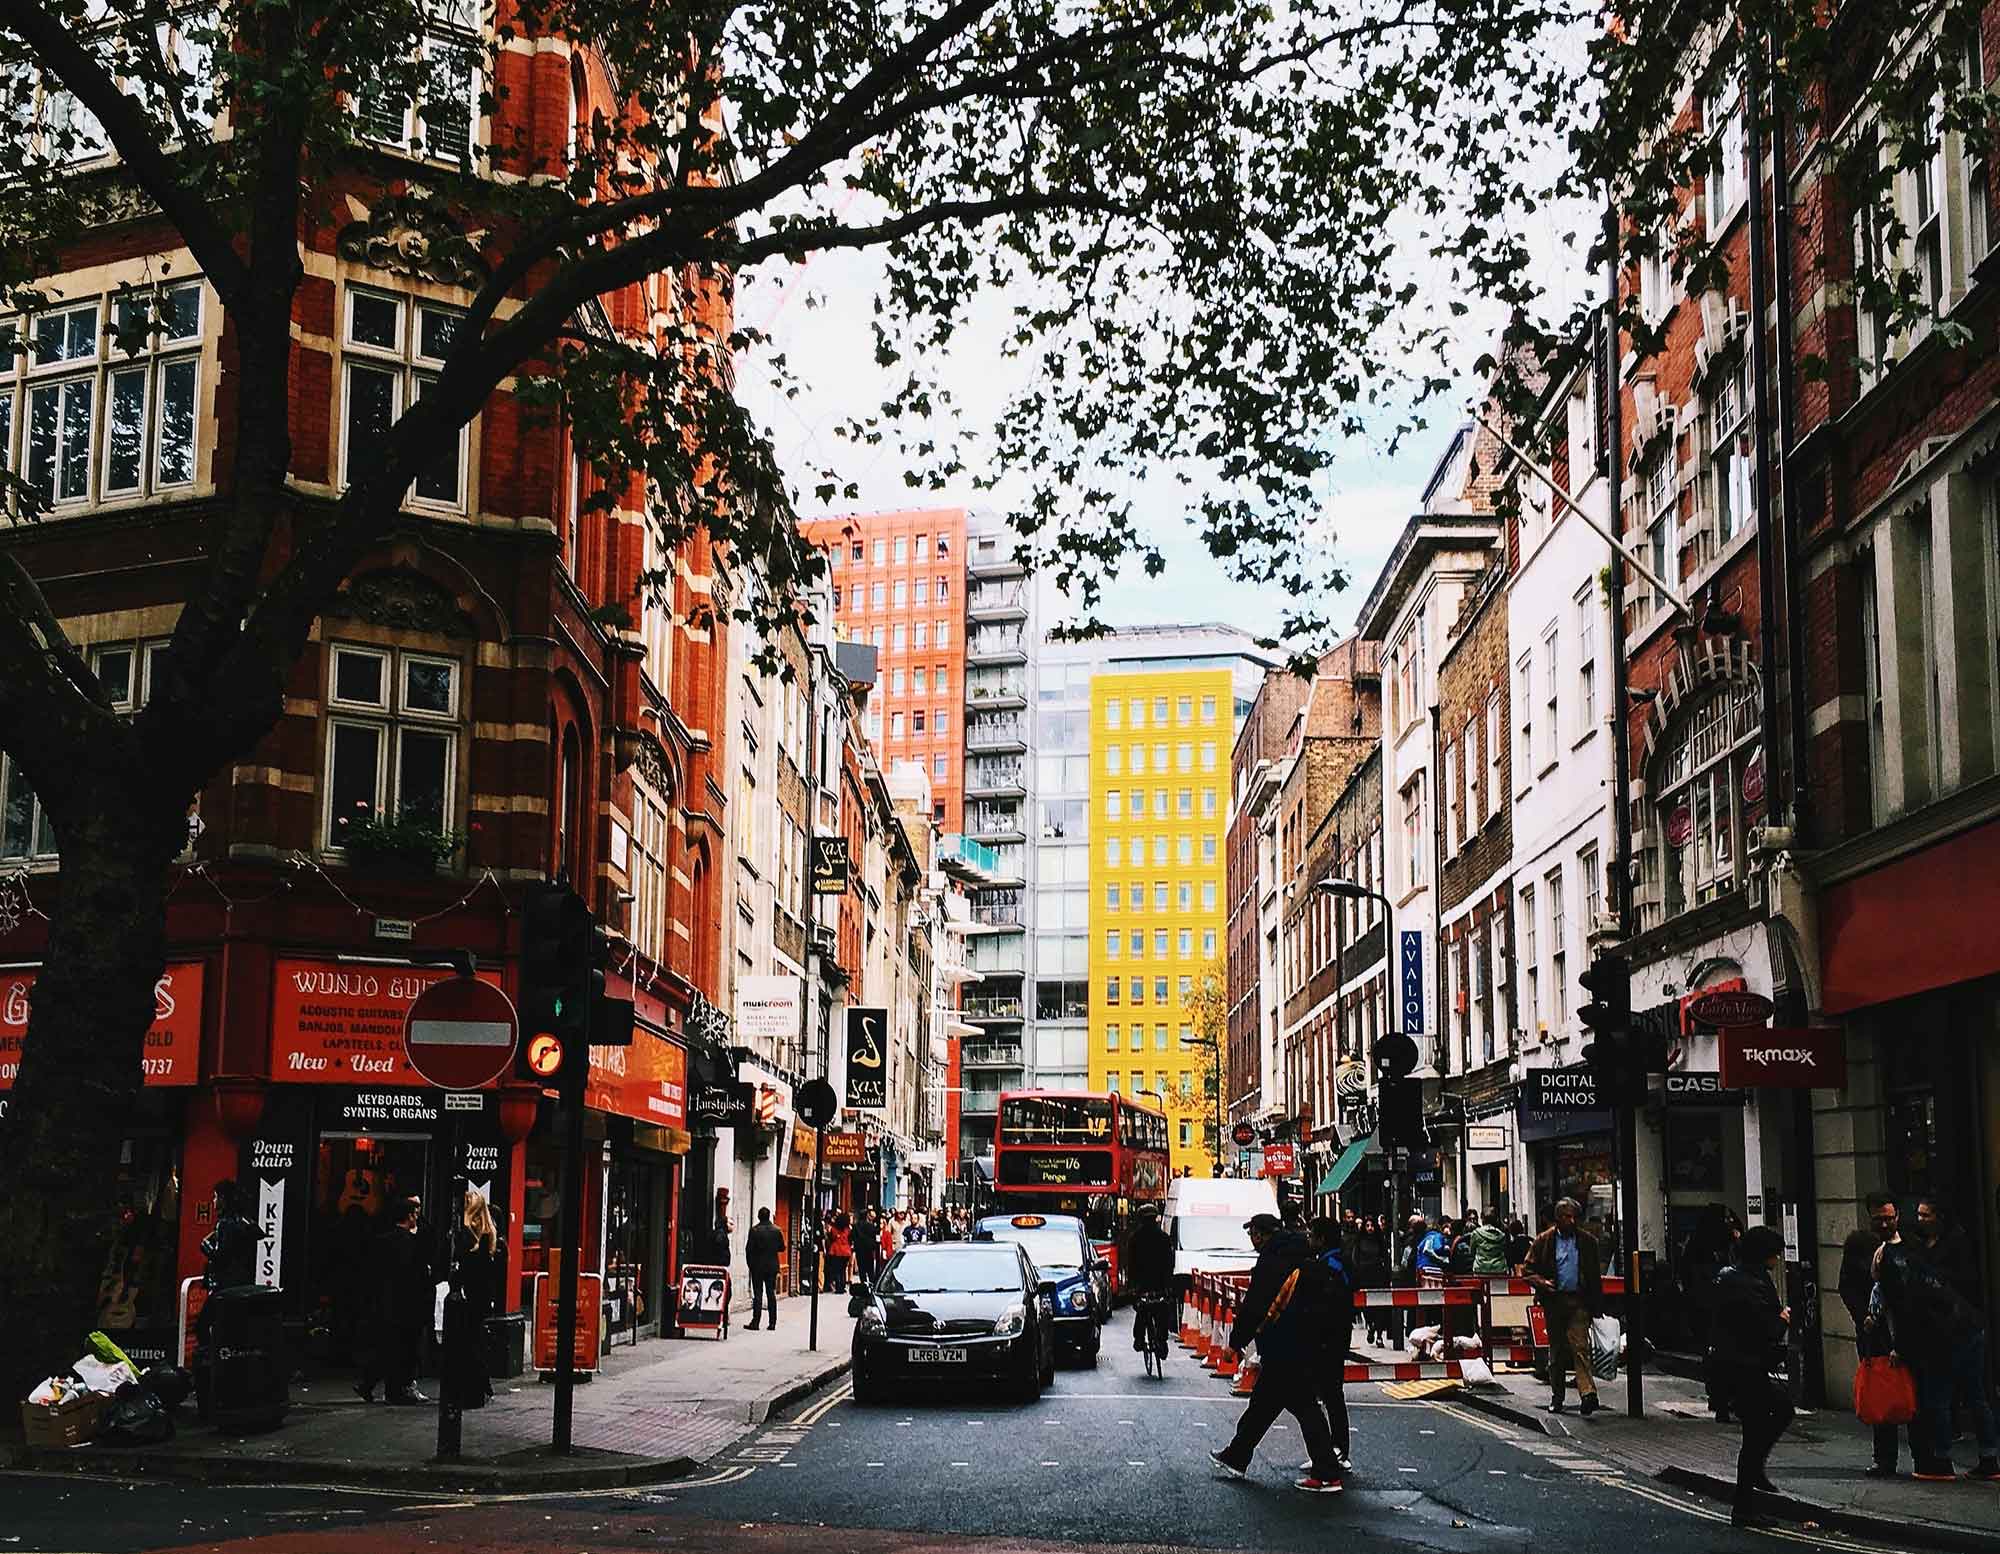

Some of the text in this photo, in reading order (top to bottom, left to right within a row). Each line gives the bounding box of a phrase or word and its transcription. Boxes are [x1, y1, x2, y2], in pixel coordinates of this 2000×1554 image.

[292, 971, 439, 999] WUNJO GUI
[1405, 932, 1419, 1031] AVALON
[742, 999, 793, 1008] musicroom
[299, 1004, 354, 1018] ACOUSTIC
[298, 1021, 348, 1034] BANJOS,
[287, 1051, 394, 1073] New Used
[1541, 1074, 1596, 1088] DIGITAL
[357, 1093, 425, 1108] KEYBOARDS,
[688, 1092, 747, 1117] Hairstylists
[1542, 1092, 1596, 1105] PIANOS
[343, 1107, 438, 1121] SYNTHS, ORGANS
[252, 1139, 294, 1155] Down
[828, 1135, 858, 1146] Wunjo
[827, 1145, 860, 1156] Guitars
[251, 1154, 294, 1169] stairs
[1065, 1157, 1081, 1170] 176
[1042, 1171, 1067, 1184] Penge
[263, 1202, 277, 1277] KEYS
